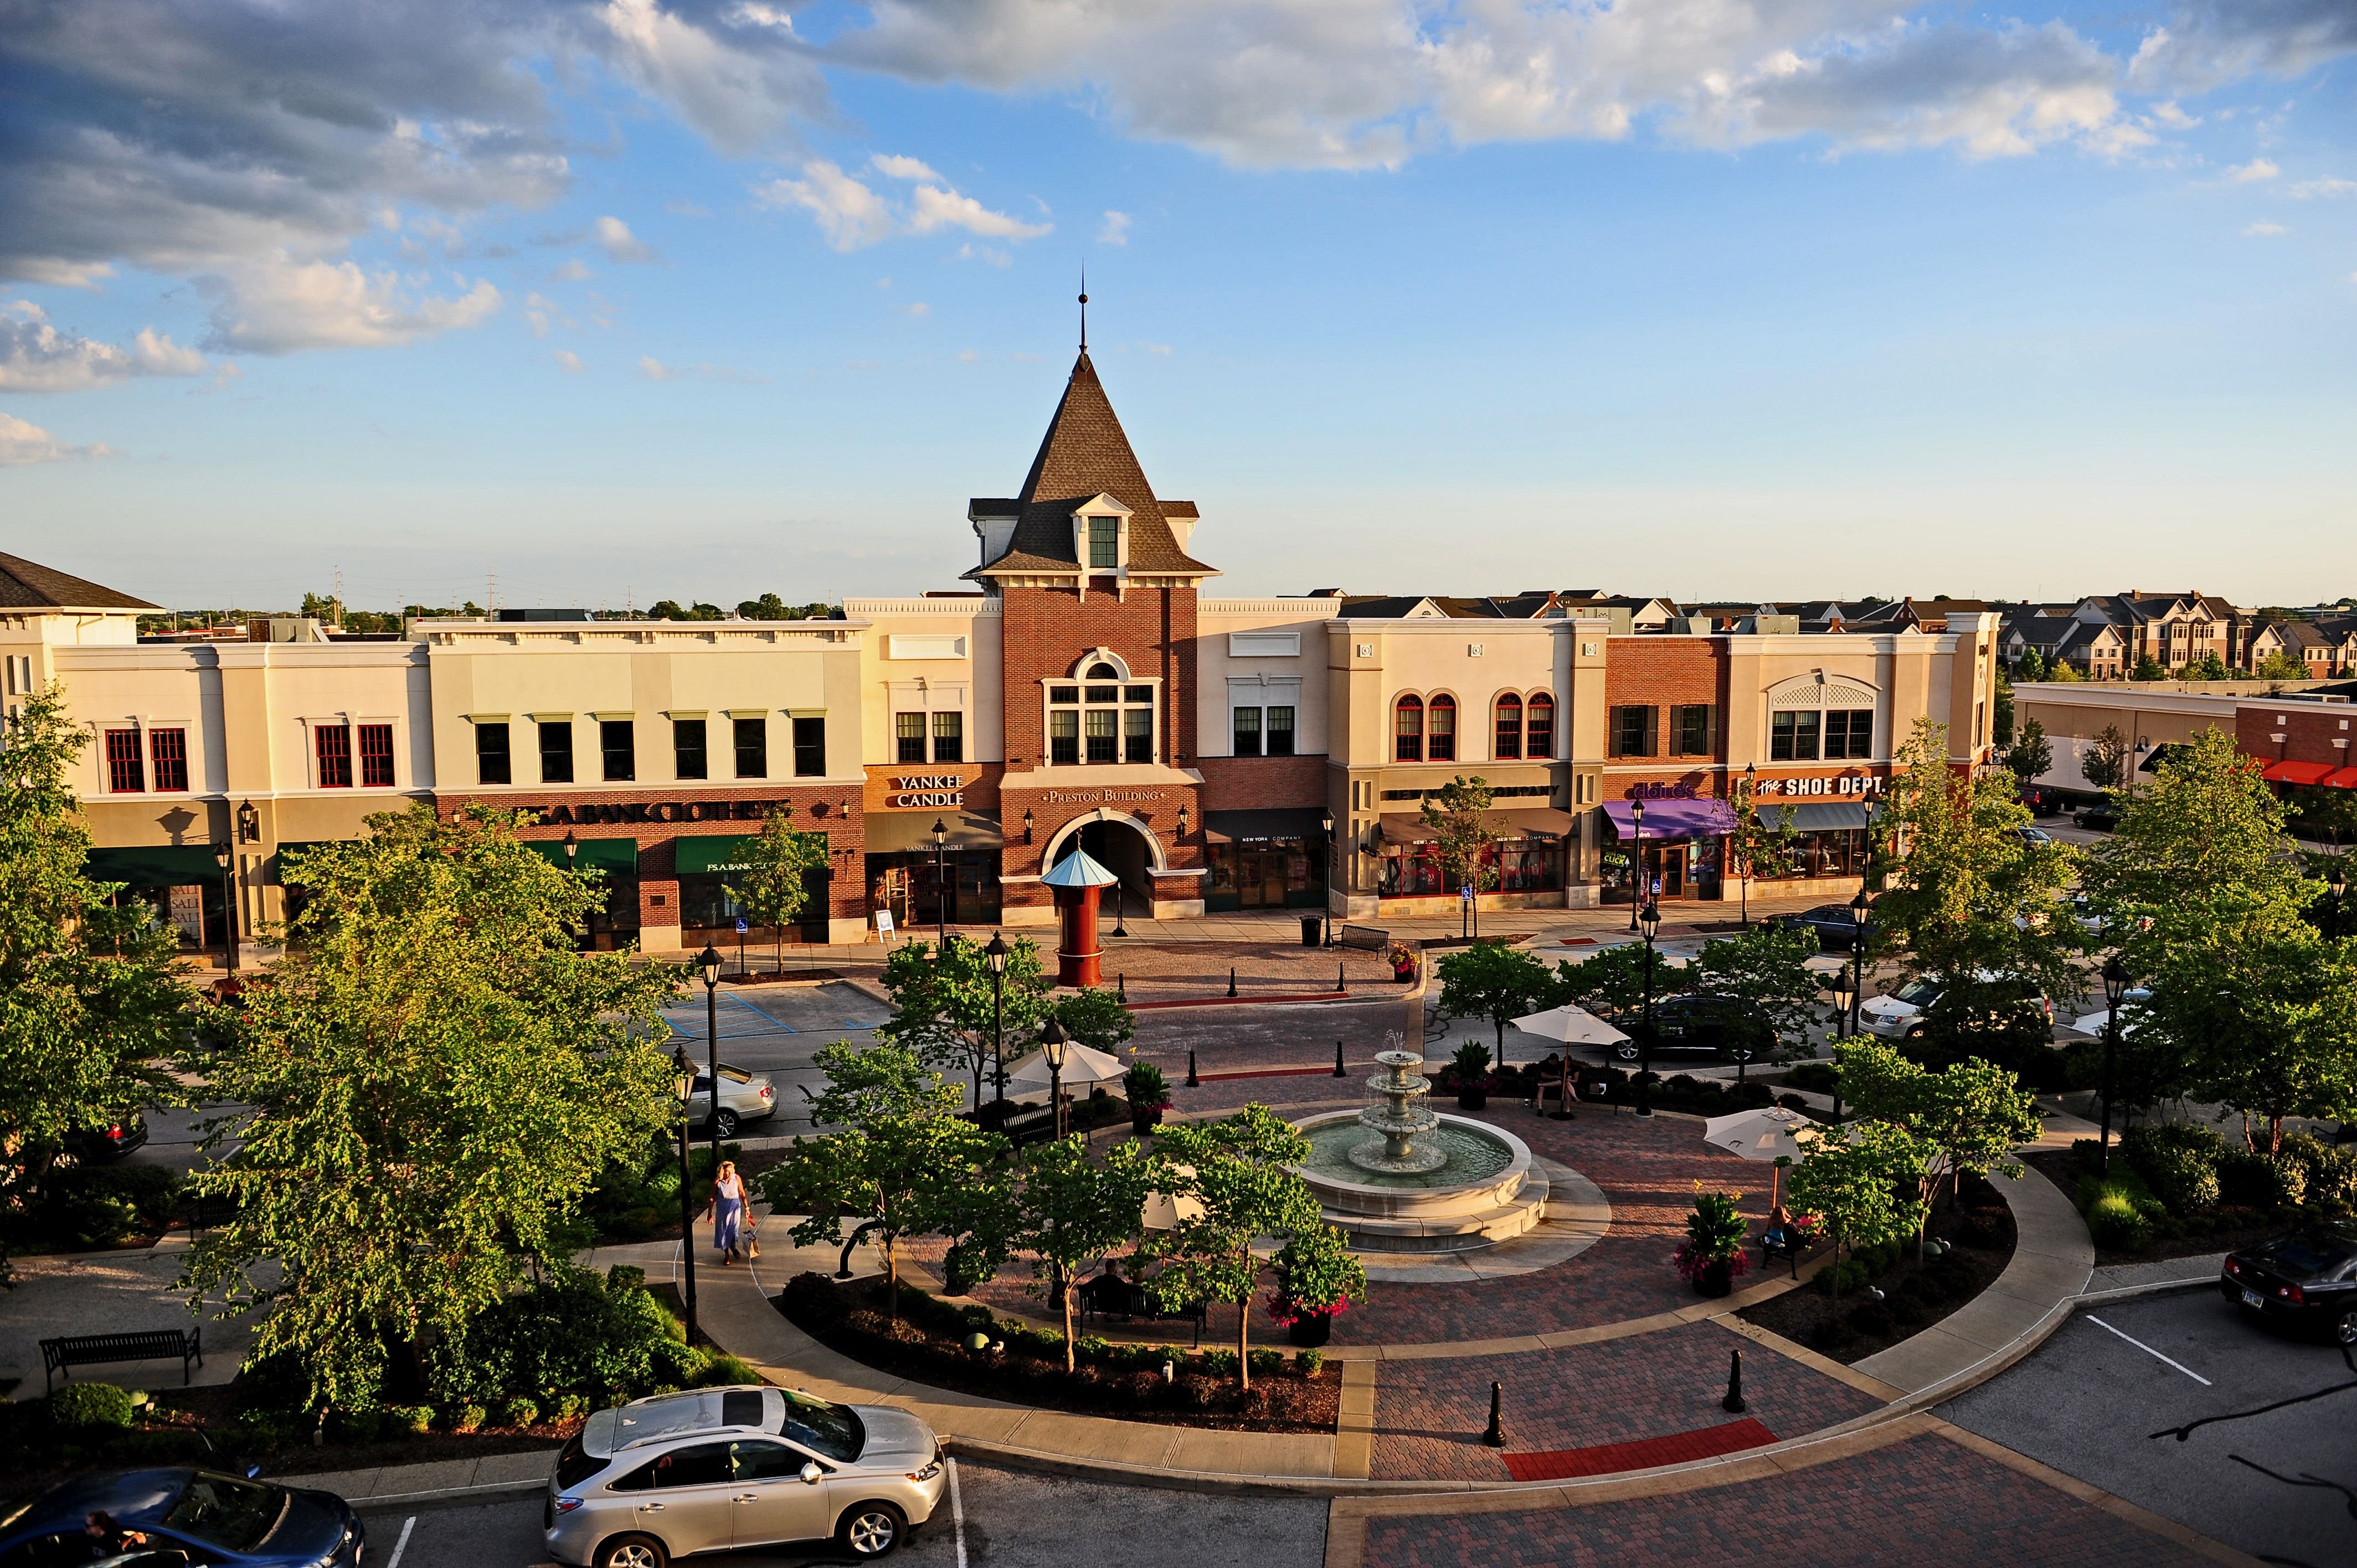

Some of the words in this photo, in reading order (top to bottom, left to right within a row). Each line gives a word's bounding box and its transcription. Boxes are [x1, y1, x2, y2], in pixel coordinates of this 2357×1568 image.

[898, 776, 963, 789] YANKEE
[1634, 781, 1694, 798] claire's
[1757, 779, 1782, 796] the
[1786, 778, 1833, 796] SHOE
[1839, 776, 1886, 794] DEPT.
[1048, 791, 1099, 803] PRESTON
[1104, 789, 1159, 801] BUILDING
[1485, 785, 1560, 798] OMPANY
[897, 793, 964, 807] CANDLE
[1604, 855, 1625, 866] CLICK
